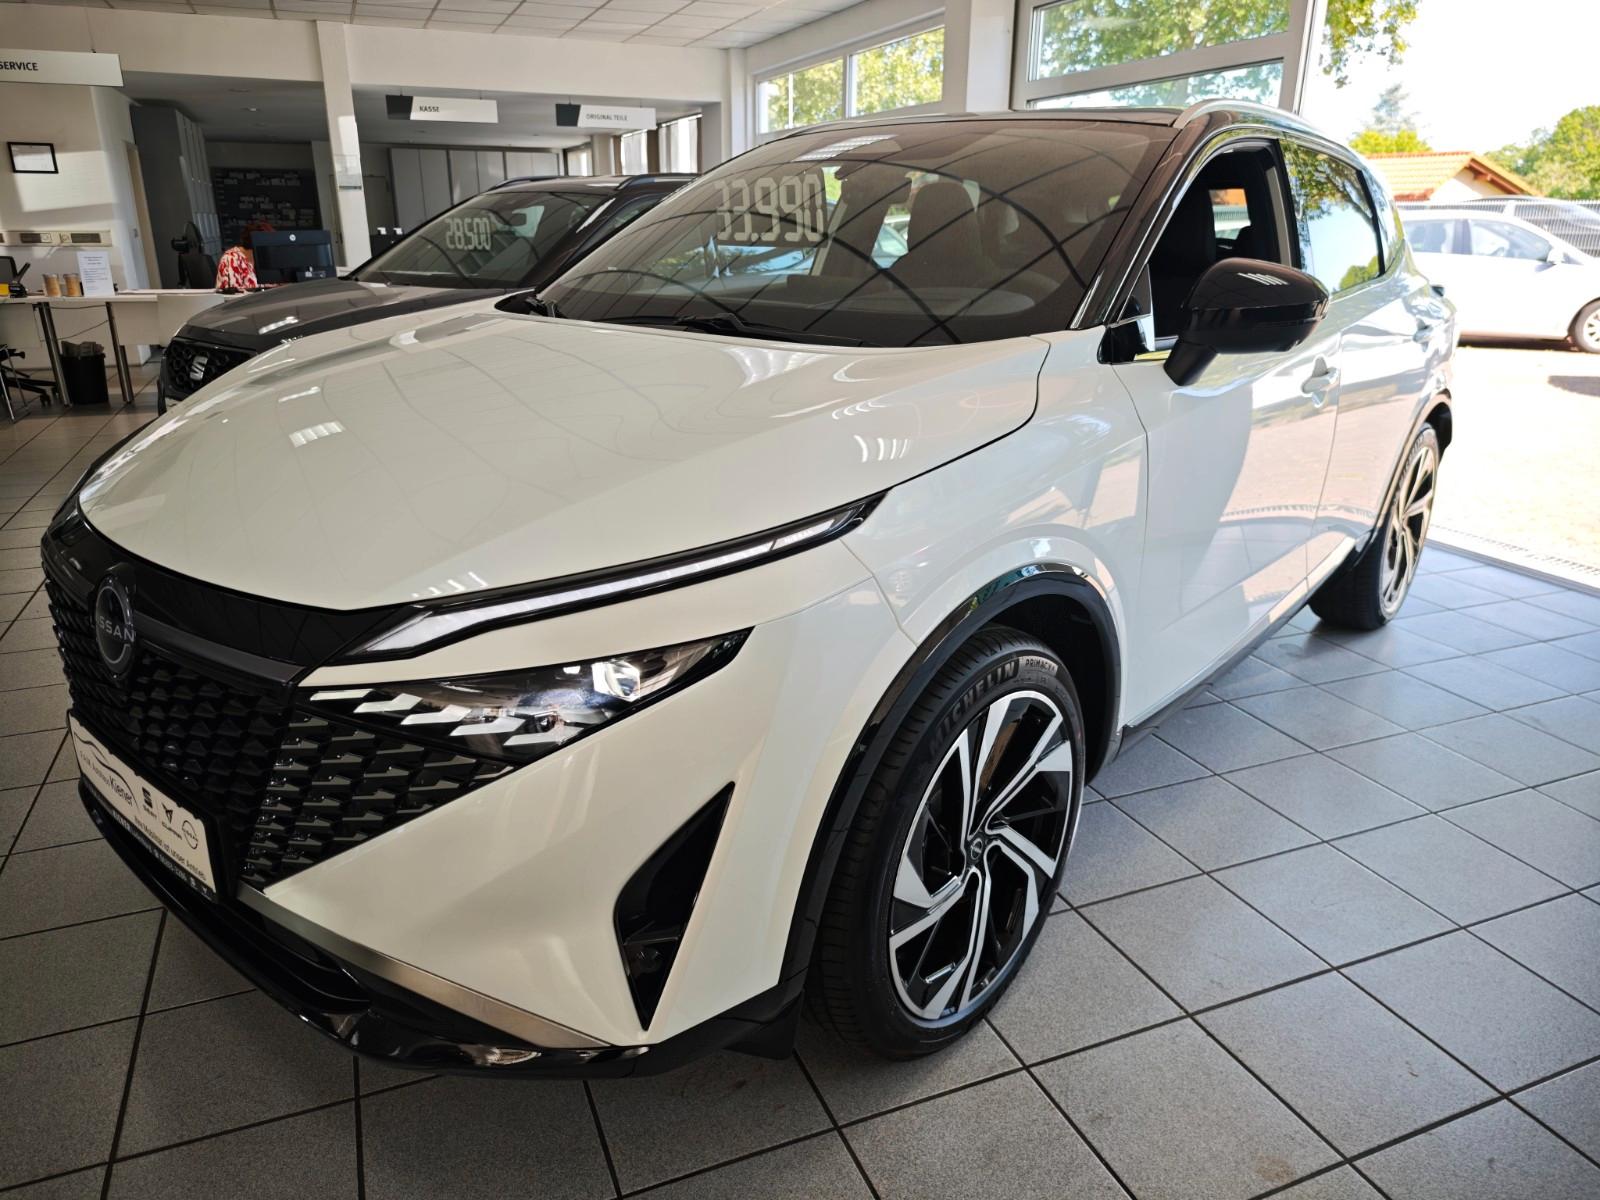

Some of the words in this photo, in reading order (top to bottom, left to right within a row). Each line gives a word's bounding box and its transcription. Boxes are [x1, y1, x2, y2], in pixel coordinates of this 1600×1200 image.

[0, 61, 39, 71] SERVICE
[419, 105, 440, 113] KASSE
[713, 173, 825, 242] 33.990
[445, 217, 491, 249] 28.500
[95, 614, 135, 642] SSAN
[928, 660, 1016, 758] MICHELIN
